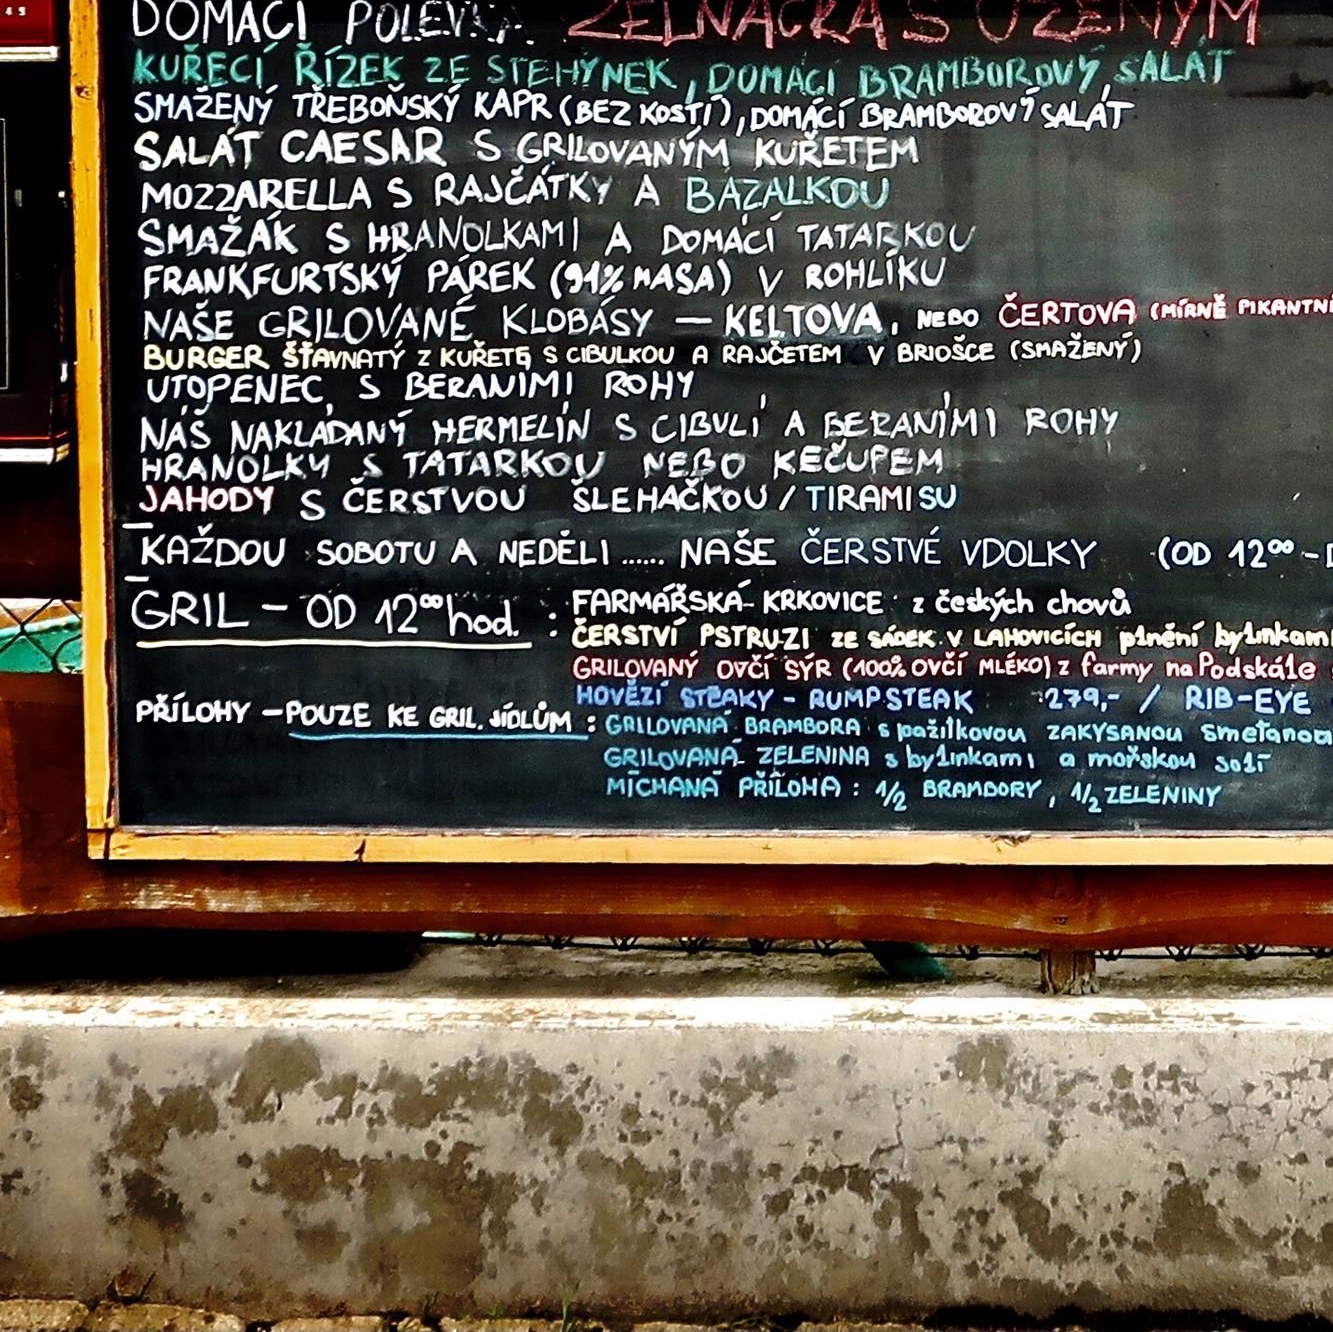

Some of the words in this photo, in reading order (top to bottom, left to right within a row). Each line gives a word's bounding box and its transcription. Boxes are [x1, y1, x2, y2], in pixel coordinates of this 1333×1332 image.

[132, 42, 279, 87] KUŘECÍ
[296, 42, 404, 88] ŘÍZEK
[424, 53, 470, 84] ZE
[858, 43, 1107, 100] BRAMBOROVÝ
[1114, 35, 1234, 86] SALÁT
[133, 84, 278, 126] SMAŽENÝ
[292, 81, 459, 124] TŘEBOŇSKÝ
[474, 88, 552, 120] KAPR
[558, 97, 631, 128] (BEZ
[281, 128, 445, 168] CAESAR
[517, 126, 730, 167] GRILOVANÝM
[755, 132, 919, 170] KUŘETEM
[141, 177, 371, 213] MOZZARELLA
[435, 166, 611, 207] RAJČÁTKY
[138, 207, 297, 258] SMAŽÁK
[368, 216, 580, 256] HRANOLKAMI
[798, 220, 977, 255] TATARKOU
[143, 252, 404, 300] FRANKFURTSKÝ
[428, 257, 536, 297] PÁREK
[804, 256, 947, 292] ROHLÍKU
[143, 301, 233, 345] NAŠE
[258, 293, 476, 344] GRILOVANÉ
[502, 295, 653, 339] KLOBÁSY
[917, 308, 979, 331] NEBO
[998, 291, 1137, 328] ČERTOVA
[143, 343, 269, 371] BURGER
[566, 344, 675, 364] CIBULKOU
[722, 336, 841, 366] RAJČETEM
[898, 333, 994, 362] BRIOŠCE
[1010, 330, 1143, 364] (SMAŽENÝ)
[147, 374, 324, 404] UTOPENEC
[604, 370, 696, 399] ROHY
[141, 403, 211, 451] NÁŠ
[231, 403, 413, 454] NAKLÁDANÝ
[433, 400, 591, 445] HERMELÍN
[825, 392, 997, 440] BERANÍMI
[141, 454, 331, 485] HRANOLKY
[774, 438, 944, 478] KEČUPEM
[139, 486, 278, 514] JAHODY
[342, 476, 526, 516] ČERSTVOU
[572, 476, 767, 512] ŠLEHAČKOU
[805, 485, 957, 512] TIRAMISU
[141, 525, 286, 568] KAŽDOU
[317, 539, 436, 567] SOBOTU
[500, 532, 610, 566] NEDĚLI
[801, 525, 942, 568] ČERSTVÉ
[961, 540, 1098, 569] VDOLKY
[1157, 536, 1212, 571] (OD
[131, 589, 250, 630] GRIL
[306, 593, 356, 630] OD
[763, 588, 883, 614] KRKOVICE
[935, 587, 1035, 621] českých
[1047, 588, 1132, 617] chovů
[571, 617, 687, 650] ČERSTVÍ
[700, 623, 809, 651] PSTRUZI
[867, 626, 935, 648] SÁDEK
[973, 623, 1102, 648] LAHOVICÍCH
[573, 650, 700, 680] GRILOVANÝ
[716, 651, 772, 680] OVČÍ
[785, 650, 832, 680] SÝR
[979, 652, 1052, 681] MLÉKO)
[1081, 655, 1153, 683] farmy
[1199, 650, 1316, 680] Podskále
[135, 693, 252, 725] PŘÍLOHY
[388, 705, 419, 728] KE
[429, 706, 486, 731] GRIL.
[489, 700, 572, 734] JÍDLŮM
[575, 676, 669, 708] HOVĚZÍ
[680, 687, 774, 712] STEAKY
[1186, 687, 1312, 716] RIB-EYE
[605, 709, 731, 736] GRILOVANÁ
[745, 716, 861, 736] BRAMBORA
[1047, 721, 1183, 744] ZAKYSANOU
[758, 747, 870, 769] ZELENINA
[606, 770, 719, 799] MÍCHANÁ
[1105, 786, 1222, 808] ZELENINY
